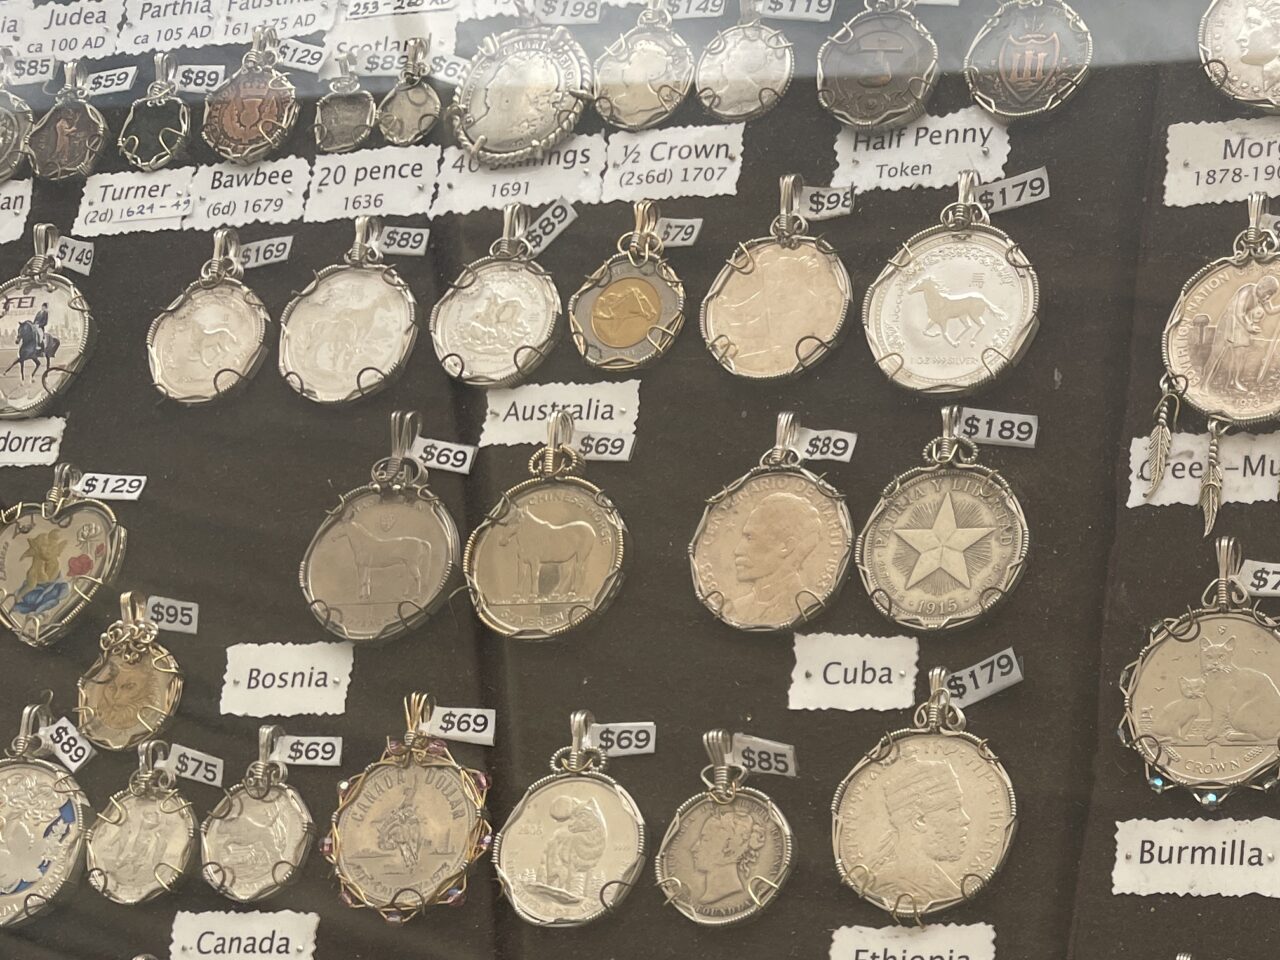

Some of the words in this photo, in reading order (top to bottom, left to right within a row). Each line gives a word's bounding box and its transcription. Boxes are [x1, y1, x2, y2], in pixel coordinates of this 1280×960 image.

[44, 9, 107, 29] Judea
[139, 0, 211, 20] Parthia
[133, 33, 152, 45] ca
[156, 28, 185, 42] 105
[188, 25, 212, 40] AD
[224, 22, 249, 36] 161
[292, 13, 316, 29] AD
[27, 41, 45, 53] ca
[50, 38, 79, 52] 100
[82, 36, 106, 49] AD
[279, 44, 323, 66] $129
[14, 60, 51, 77] $85
[180, 68, 218, 87] $89
[91, 72, 128, 91] $59
[849, 125, 906, 153] Half
[913, 123, 995, 149] Penny
[650, 141, 731, 162] Crown
[210, 167, 293, 191] Bawbee
[318, 166, 346, 187] 20
[353, 161, 423, 183] pence
[619, 168, 673, 188] (2s6d)
[680, 166, 728, 183] 1707
[876, 162, 932, 179] Token
[99, 180, 172, 203] Turner
[490, 182, 531, 198] 1691
[978, 176, 1046, 212] $179
[206, 201, 237, 219] (6d)
[243, 197, 284, 216] 1679
[343, 195, 383, 212] 1636
[526, 205, 569, 246] $89
[661, 224, 696, 243] $79
[382, 228, 424, 251] $89
[56, 243, 93, 266] $149
[242, 242, 287, 265] $169
[502, 400, 615, 423] Australia
[962, 413, 1034, 442] $189
[421, 443, 468, 469] $69
[580, 436, 625, 456] $69
[805, 436, 850, 457] $89
[82, 476, 143, 495] $129
[150, 603, 194, 627] $95
[246, 668, 329, 691] Bosnia
[822, 660, 894, 686] Cuba
[946, 653, 1015, 701] $179
[439, 711, 490, 734] $69
[49, 725, 87, 764] $89
[287, 740, 336, 761] $69
[598, 728, 651, 750] $69
[175, 753, 218, 783] $75
[740, 746, 789, 774] $85
[1139, 839, 1265, 868] Burmilla
[196, 930, 292, 956] Canada
